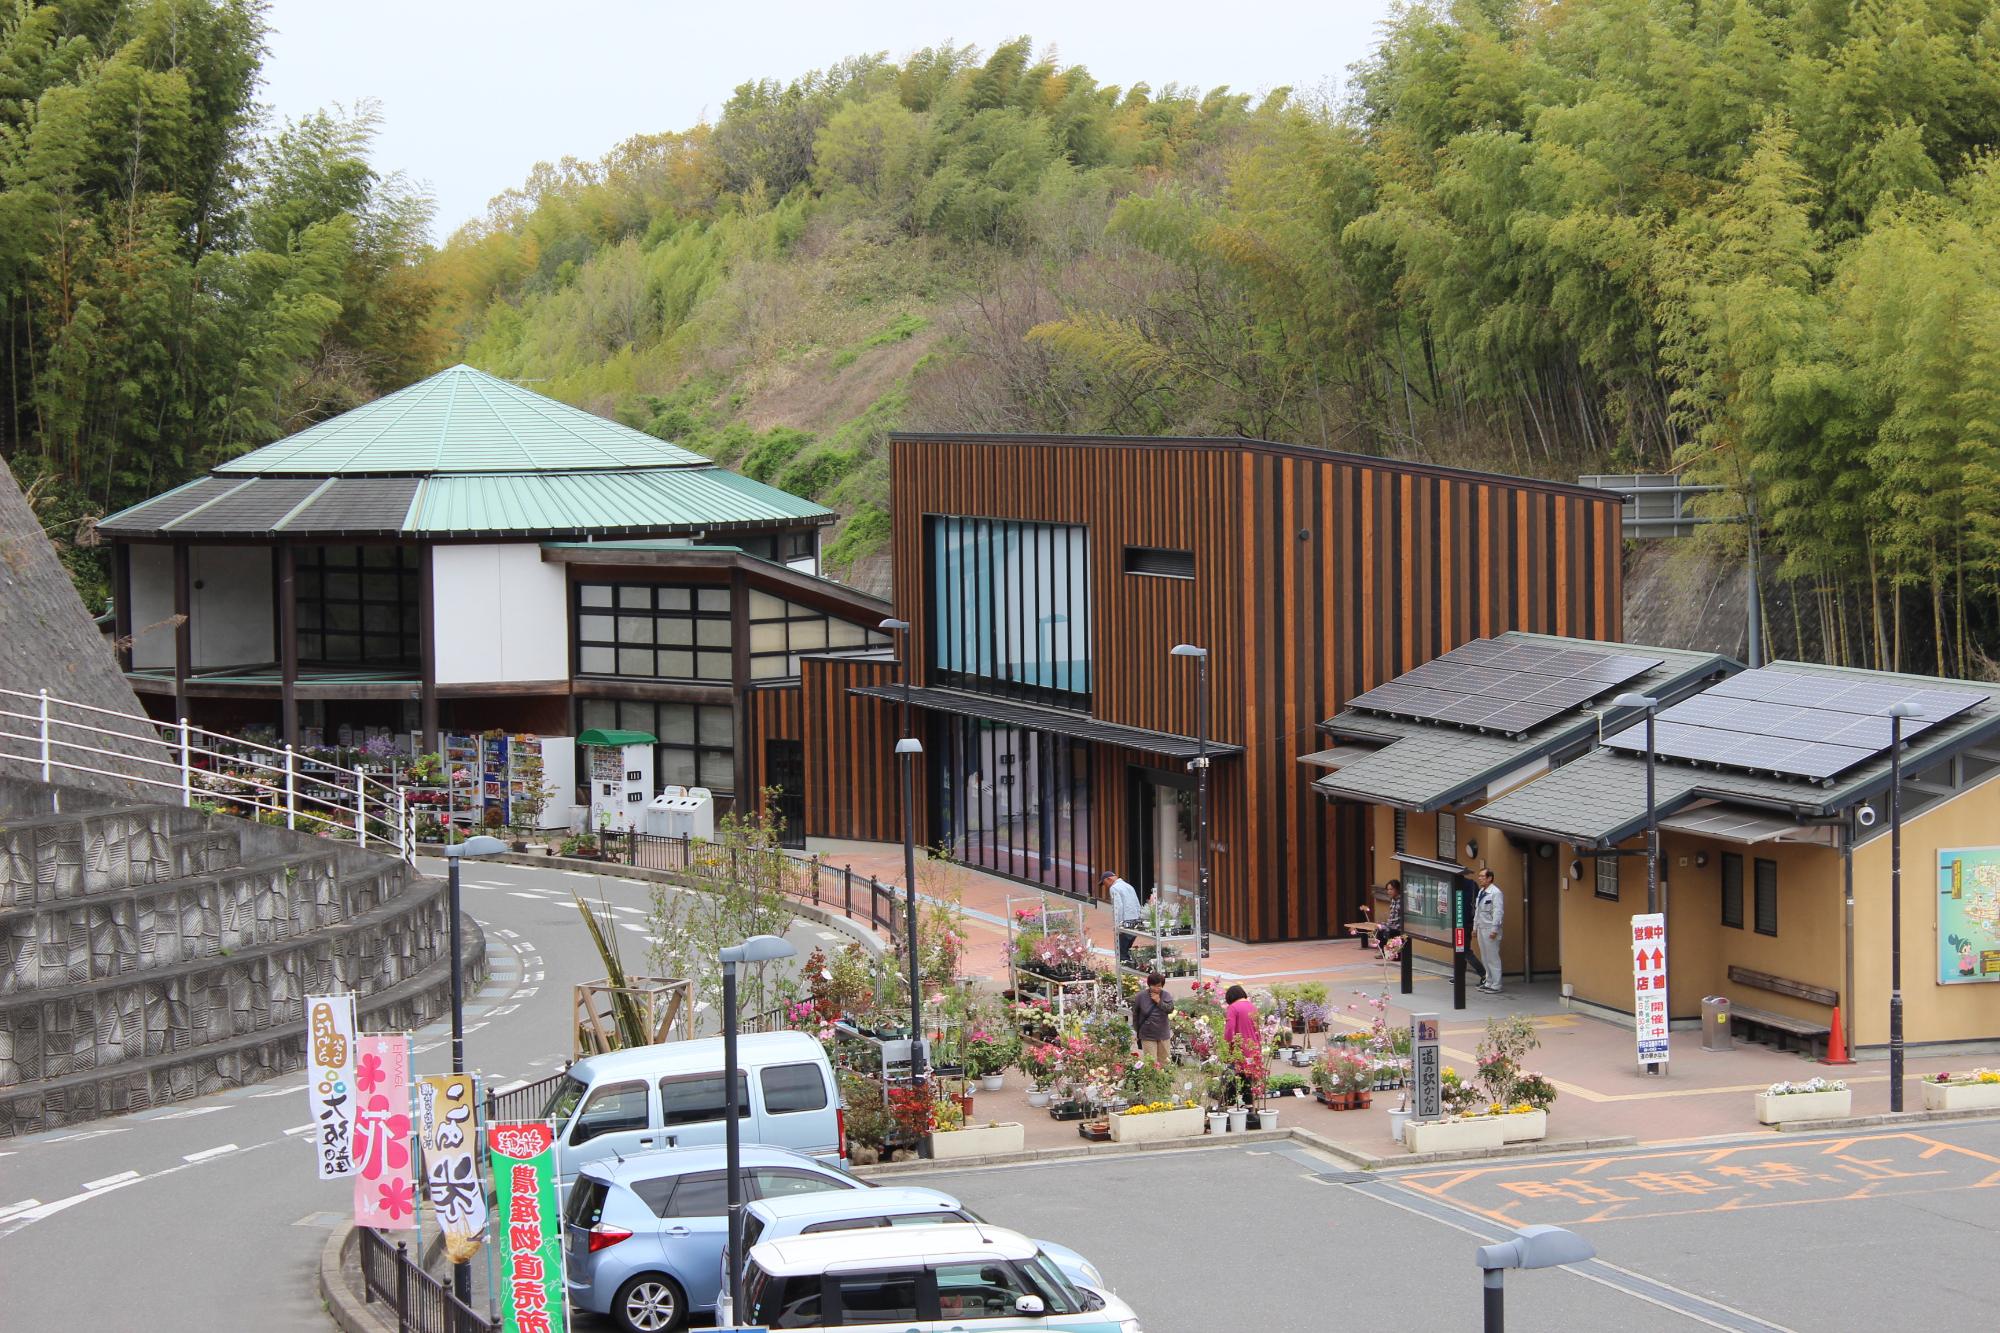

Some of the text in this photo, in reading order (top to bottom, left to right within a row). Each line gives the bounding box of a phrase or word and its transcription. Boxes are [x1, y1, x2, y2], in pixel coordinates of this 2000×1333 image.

[1635, 925, 1663, 940] 営業中
[1651, 1002, 1664, 1038] 開催中
[1422, 1049, 1436, 1113] 道の駅かなん
